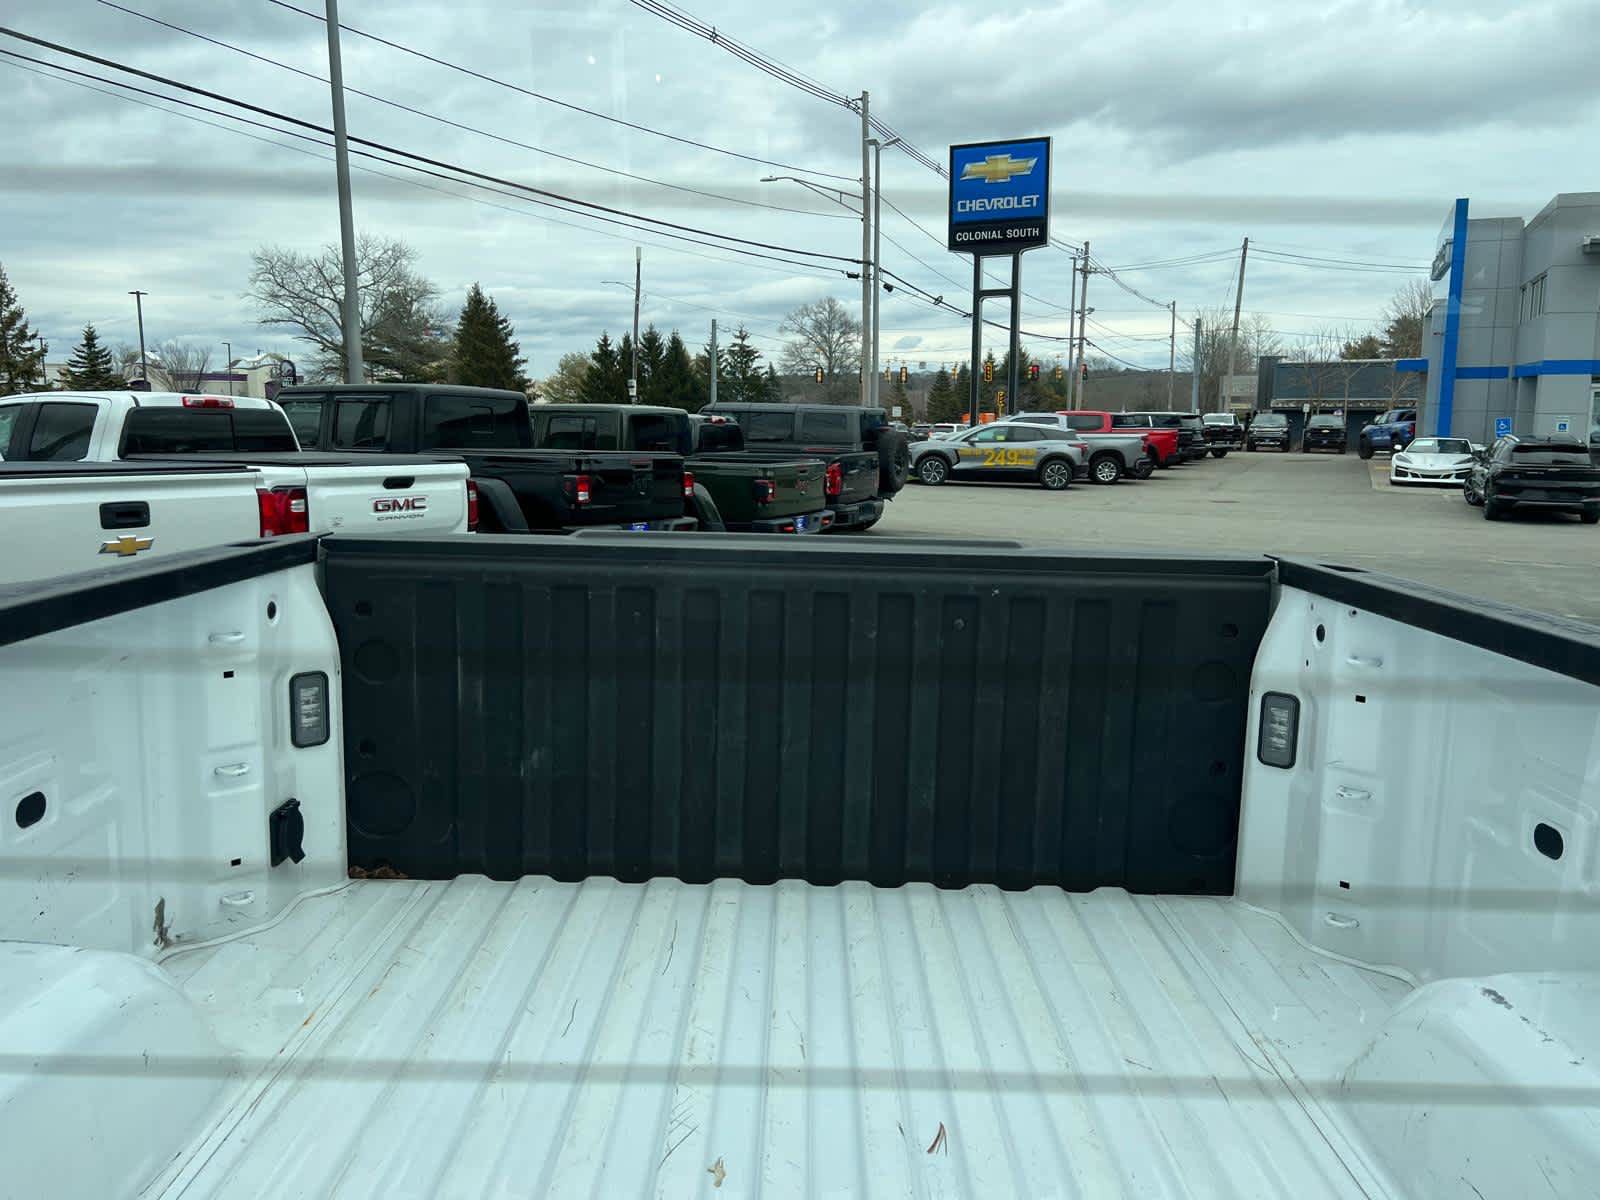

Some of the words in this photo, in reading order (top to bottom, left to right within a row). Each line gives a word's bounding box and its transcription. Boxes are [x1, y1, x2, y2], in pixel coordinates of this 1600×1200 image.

[957, 194, 1040, 213] CHEVROLET
[955, 230, 1003, 241] COLONIAL
[1006, 227, 1040, 239] SOUTH
[373, 497, 427, 513] GMC
